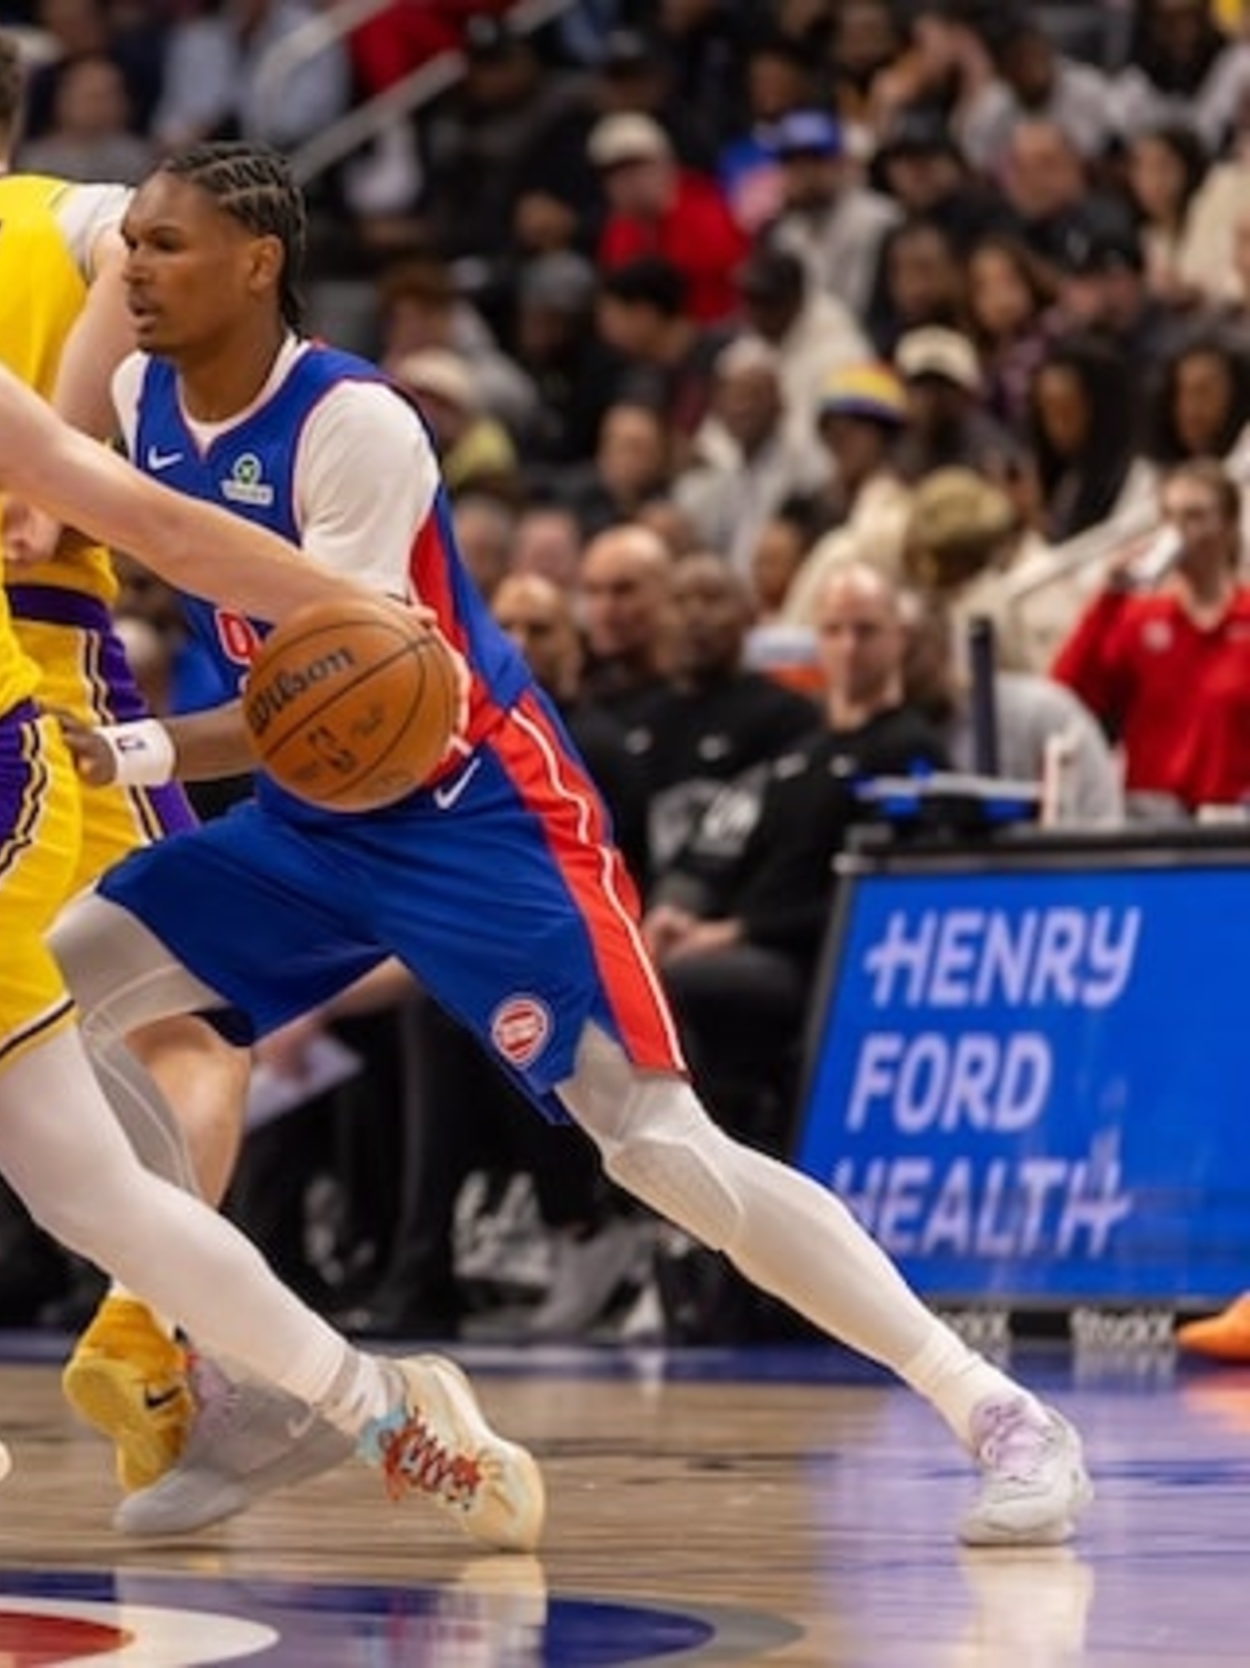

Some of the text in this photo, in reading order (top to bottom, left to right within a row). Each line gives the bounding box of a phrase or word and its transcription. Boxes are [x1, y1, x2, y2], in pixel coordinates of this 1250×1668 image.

[862, 905, 1142, 1009] HENRY
[845, 1029, 1053, 1135] FORD
[830, 1155, 1132, 1259] HEALTH
